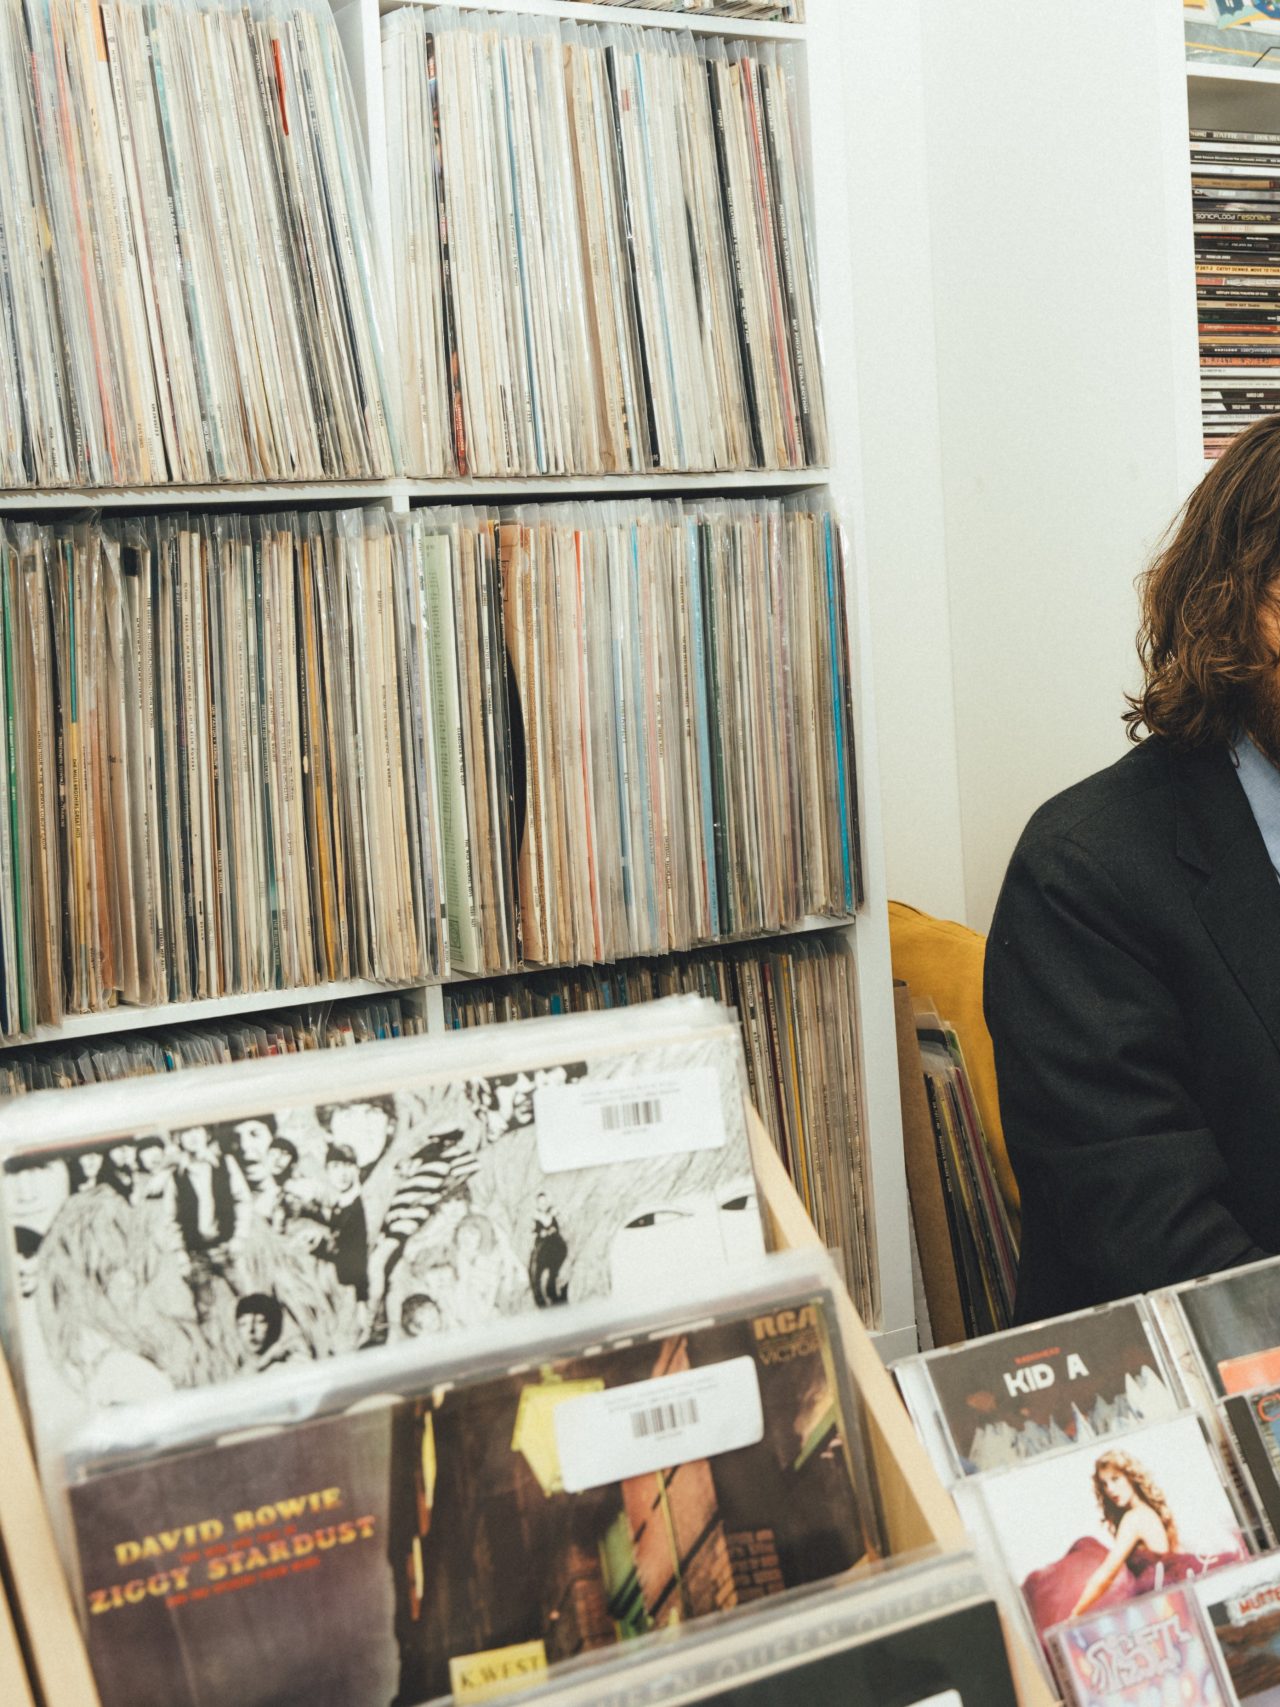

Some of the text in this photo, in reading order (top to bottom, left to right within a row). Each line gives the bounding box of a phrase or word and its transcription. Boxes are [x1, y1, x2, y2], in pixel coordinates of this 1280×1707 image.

[777, 204, 787, 239] RICHARD
[781, 240, 793, 294] CLAYDERMAN
[792, 332, 802, 364] PRIVATE
[796, 365, 808, 414] COLLECTION
[72, 809, 80, 827] GREAT
[754, 1306, 817, 1341] RCA
[1003, 1353, 1090, 1397] KID A
[114, 1519, 225, 1567] DAVID
[232, 1486, 342, 1533] BOWIE
[88, 1566, 191, 1616] ZIGGY
[206, 1514, 377, 1582] STARDUST
